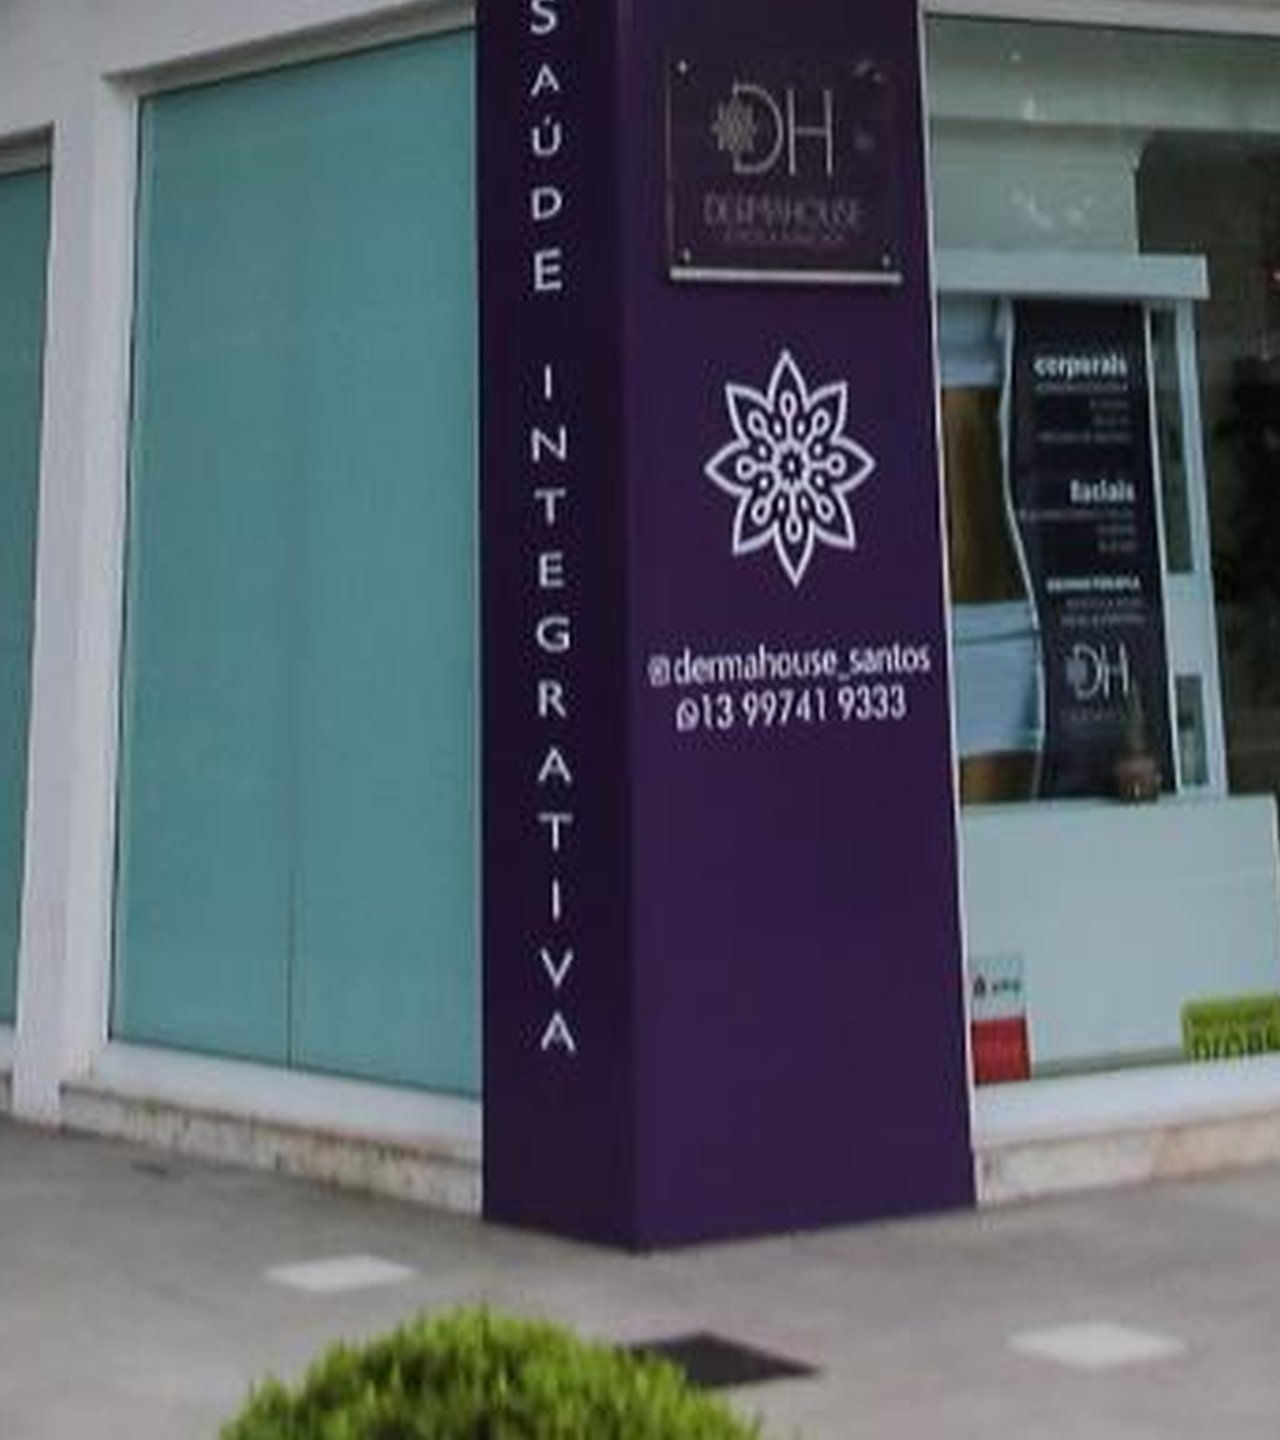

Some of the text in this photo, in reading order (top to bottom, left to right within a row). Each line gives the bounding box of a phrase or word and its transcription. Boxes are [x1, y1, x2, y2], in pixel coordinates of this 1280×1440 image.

[647, 642, 931, 687] @dermahouse_santos
[530, 363, 575, 1053] INTEGRATIVA
[703, 683, 908, 730] 13 99741 9333
